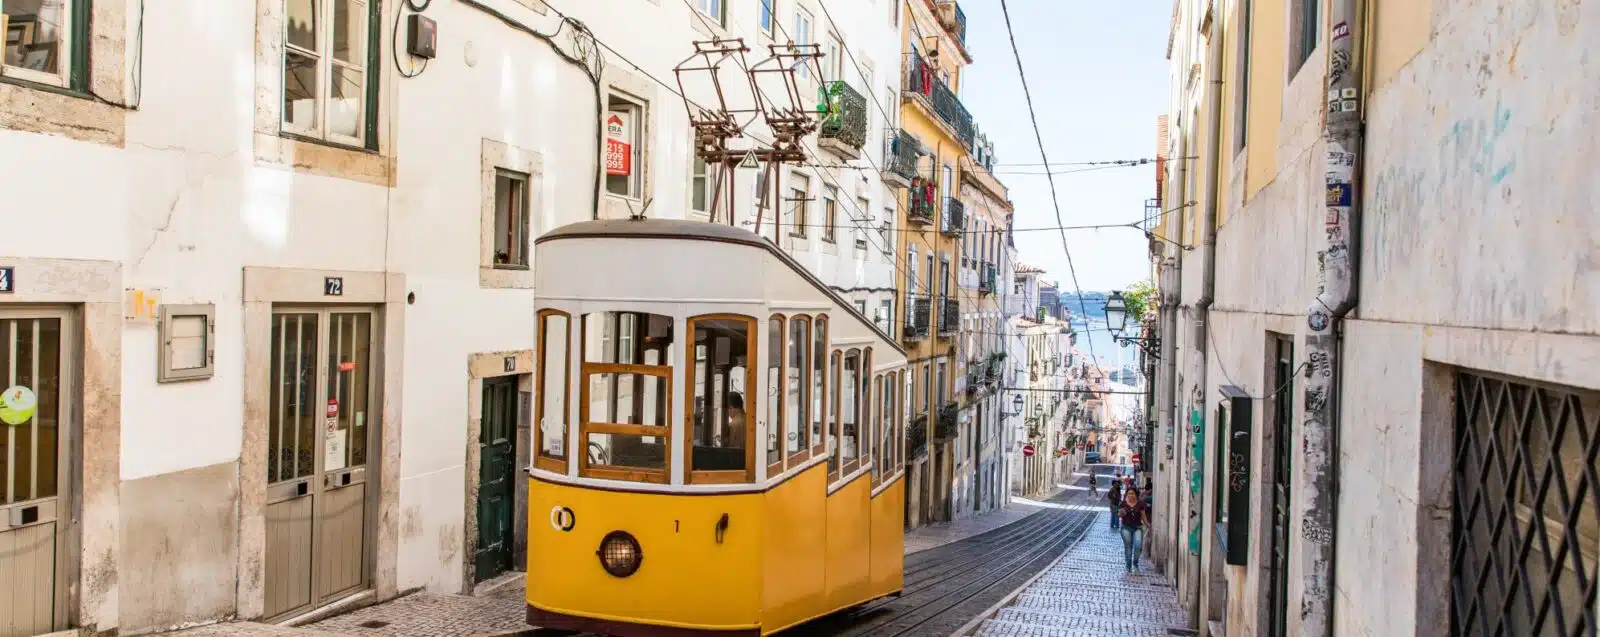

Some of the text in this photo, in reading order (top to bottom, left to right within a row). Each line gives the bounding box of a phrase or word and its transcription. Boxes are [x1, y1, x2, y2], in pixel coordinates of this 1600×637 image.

[608, 125, 622, 133] ERA
[607, 143, 624, 153] 215
[607, 152, 624, 161] 999
[606, 160, 624, 169] 995
[328, 278, 341, 295] 72
[507, 358, 515, 372] 70
